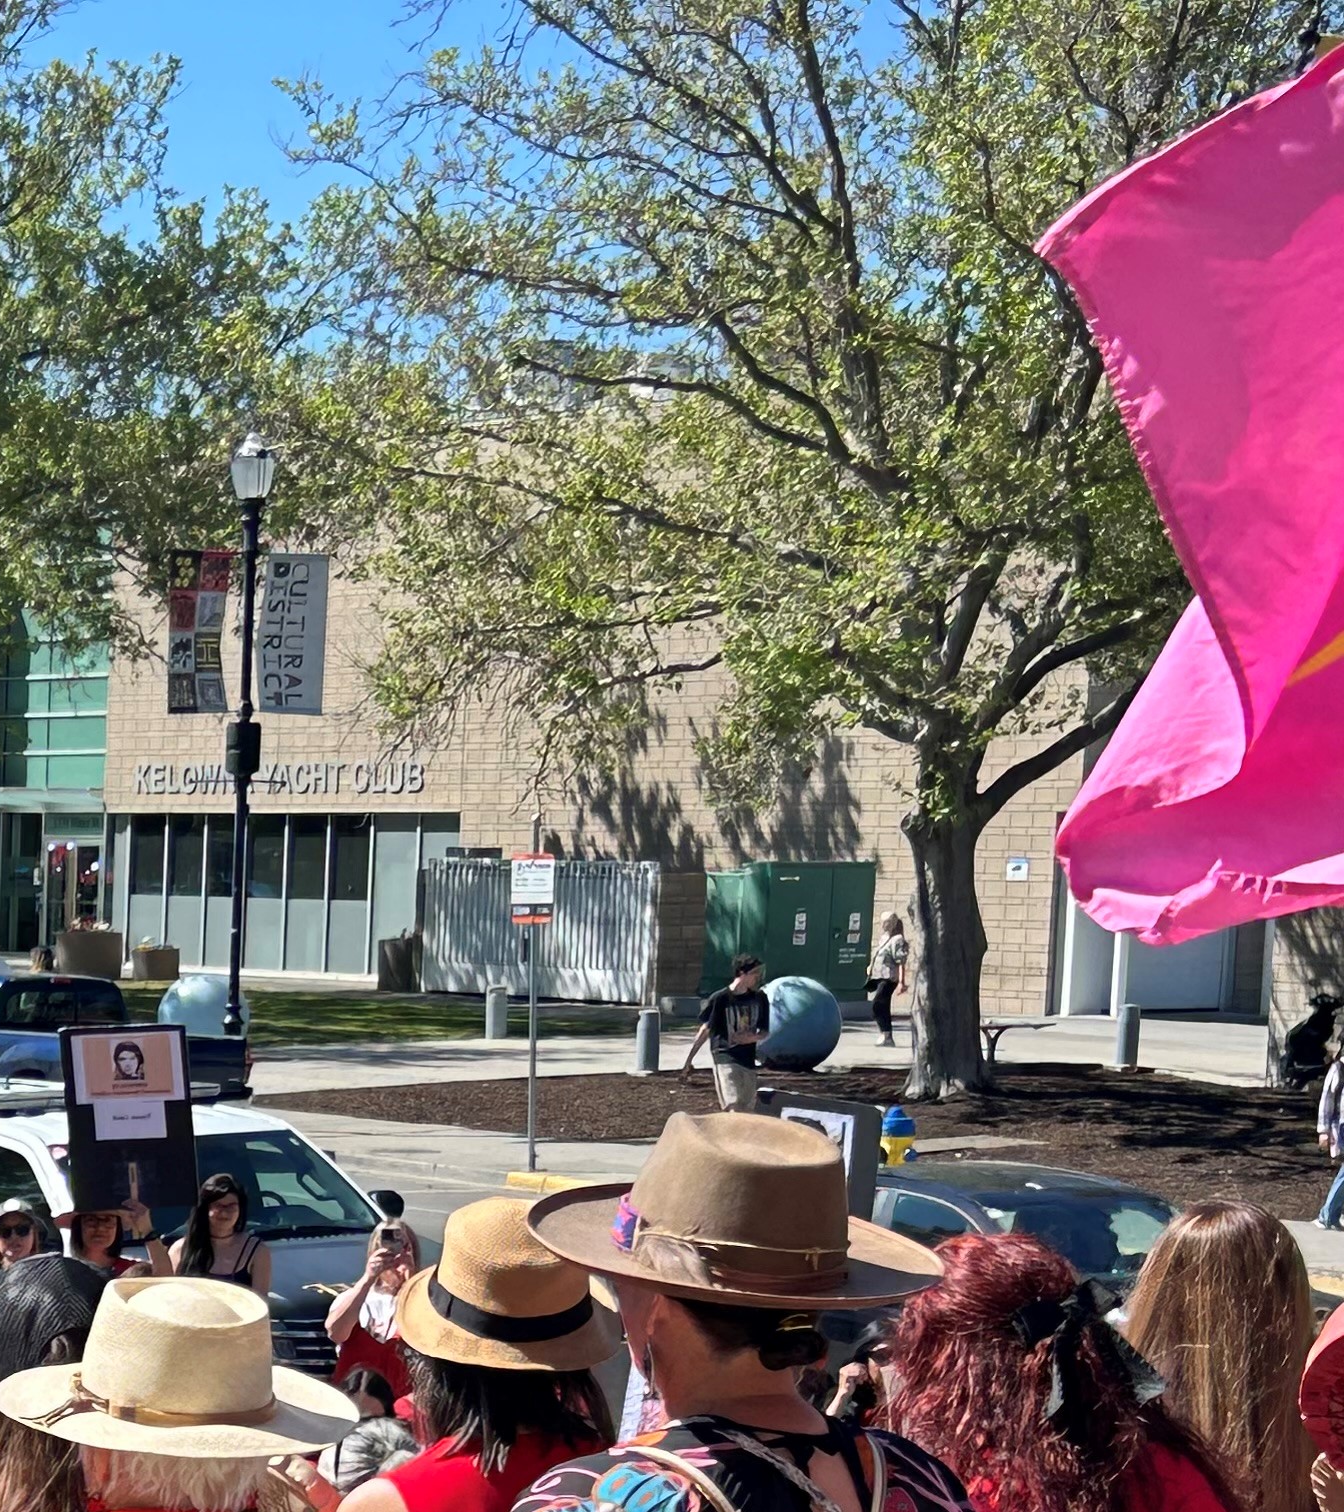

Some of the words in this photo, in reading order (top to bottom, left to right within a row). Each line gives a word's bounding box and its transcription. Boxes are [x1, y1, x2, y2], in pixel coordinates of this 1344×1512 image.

[262, 562, 291, 707] DISTRICT
[283, 563, 310, 706] CULTURAL
[264, 762, 346, 795] YACHT
[355, 761, 426, 794] CLUB
